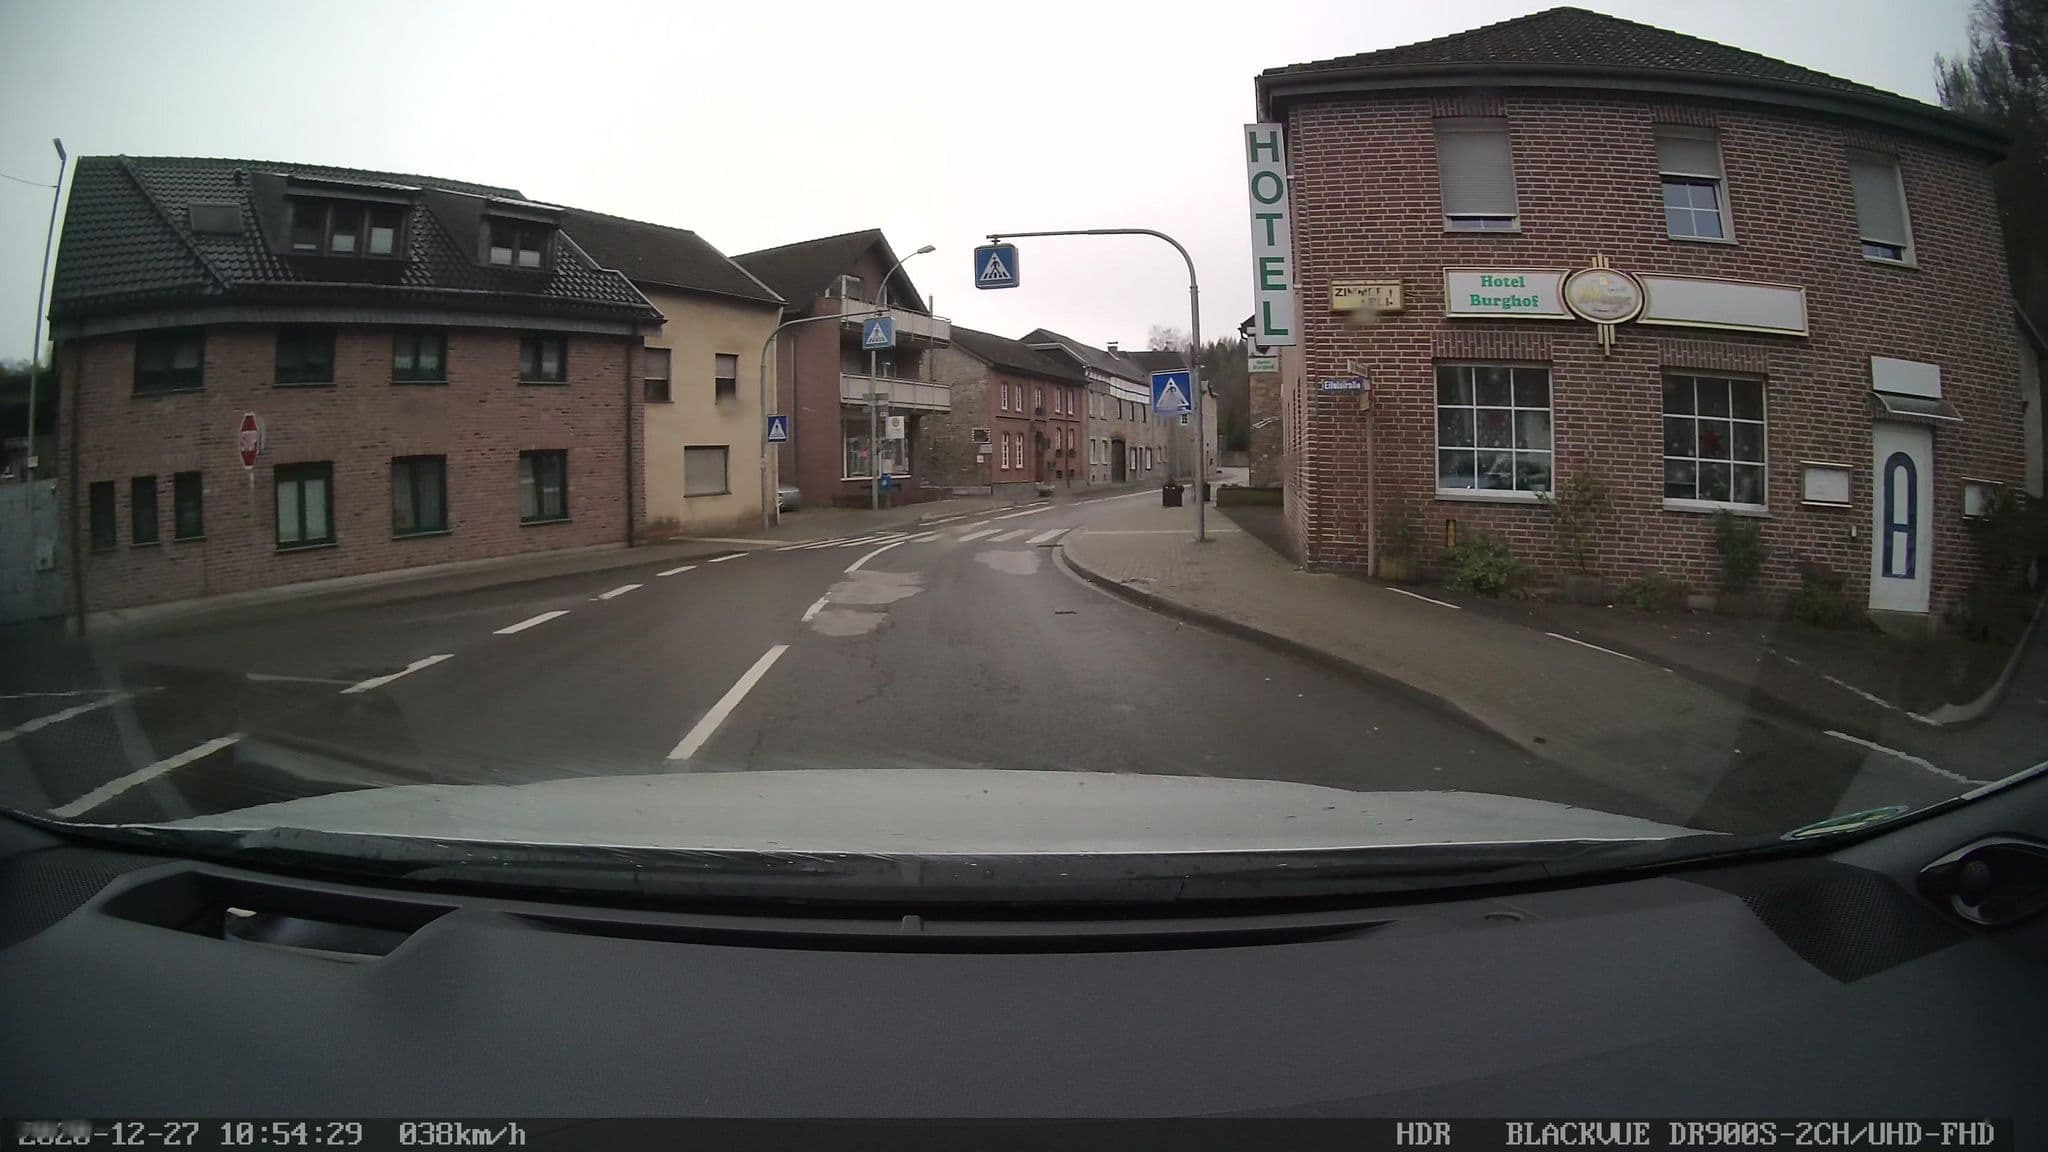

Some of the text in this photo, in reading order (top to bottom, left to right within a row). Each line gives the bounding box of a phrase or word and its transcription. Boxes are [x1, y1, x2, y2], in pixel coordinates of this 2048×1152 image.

[1248, 131, 1288, 336] HOTEL
[1480, 275, 1526, 289] Hotel
[1469, 292, 1539, 310] Burghof
